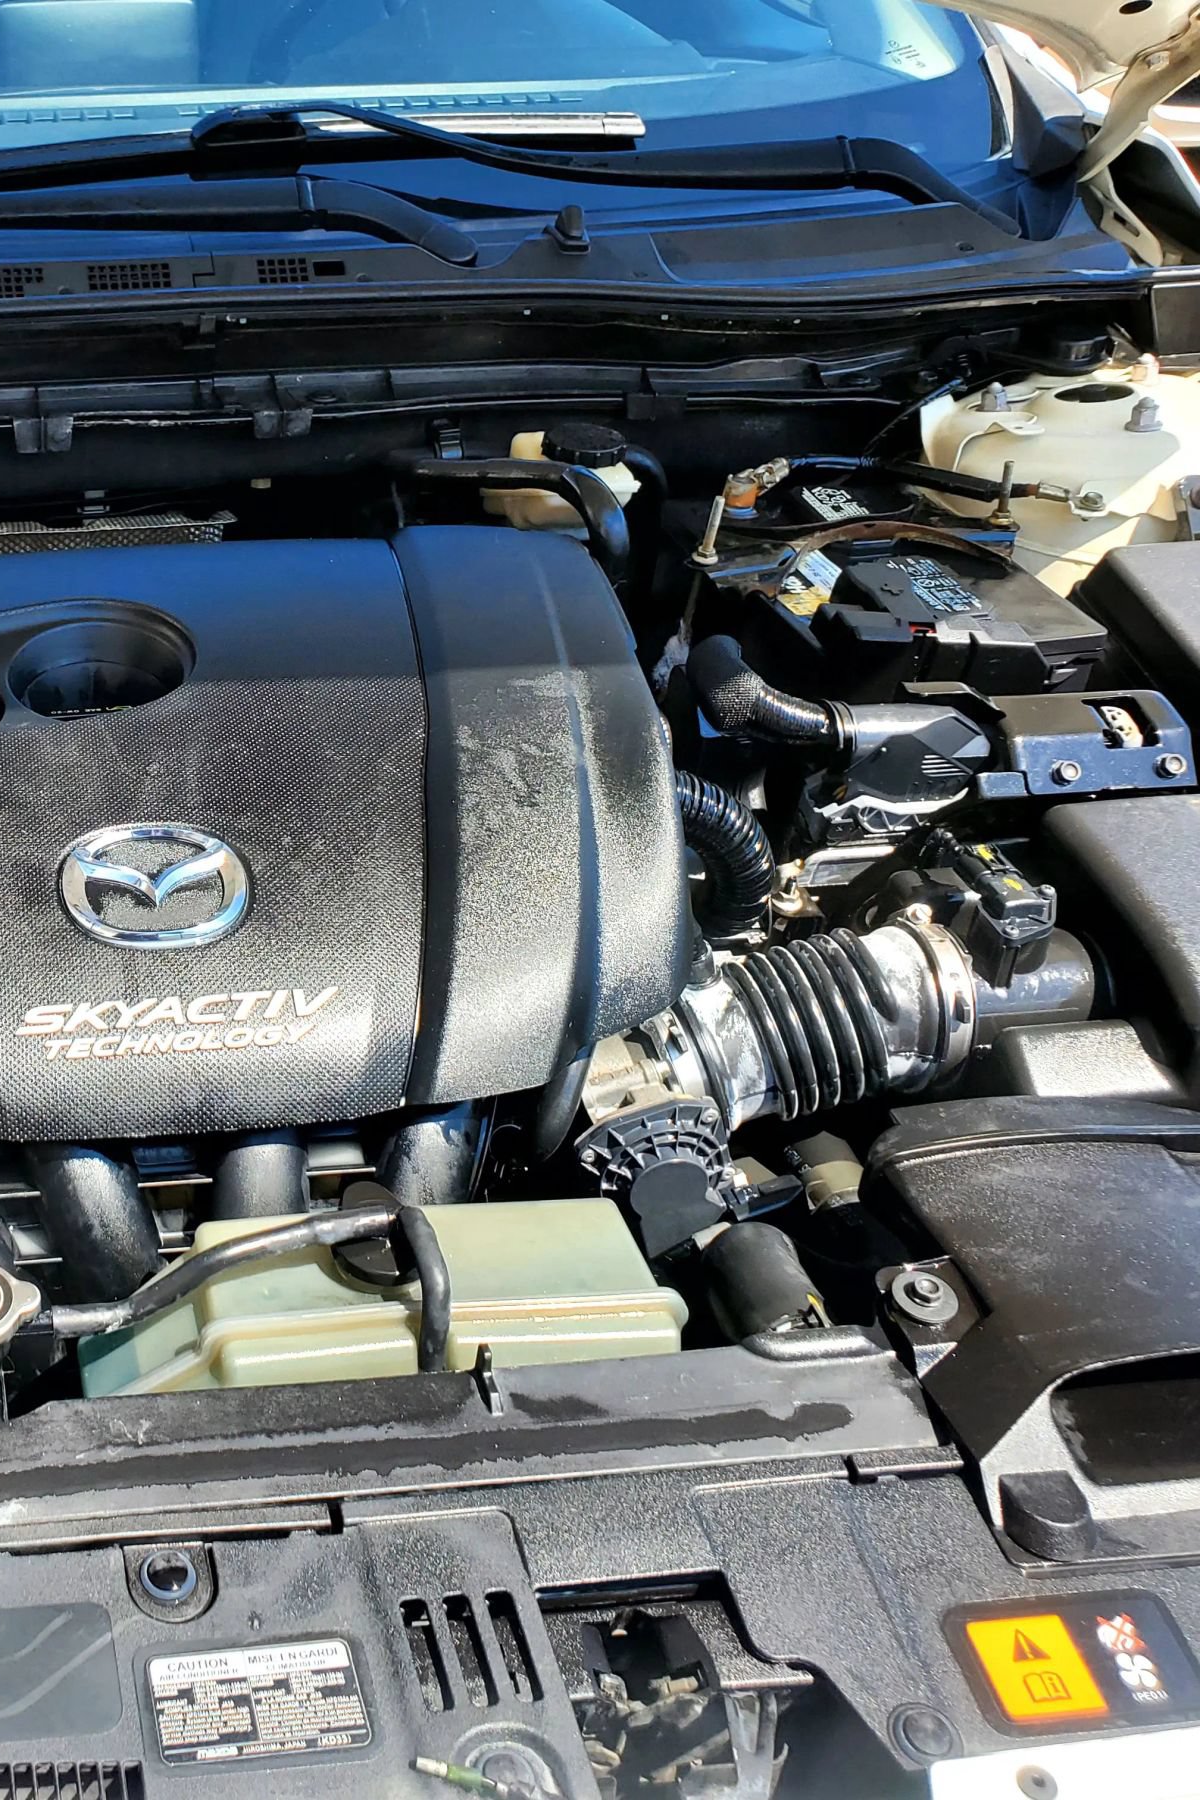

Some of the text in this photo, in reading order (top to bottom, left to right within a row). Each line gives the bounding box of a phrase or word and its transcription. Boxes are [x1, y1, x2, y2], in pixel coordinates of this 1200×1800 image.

[15, 986, 340, 1036] SKYACTIV
[44, 1024, 314, 1060] TECHNOLOGY
[167, 1658, 229, 1672] CAUTION
